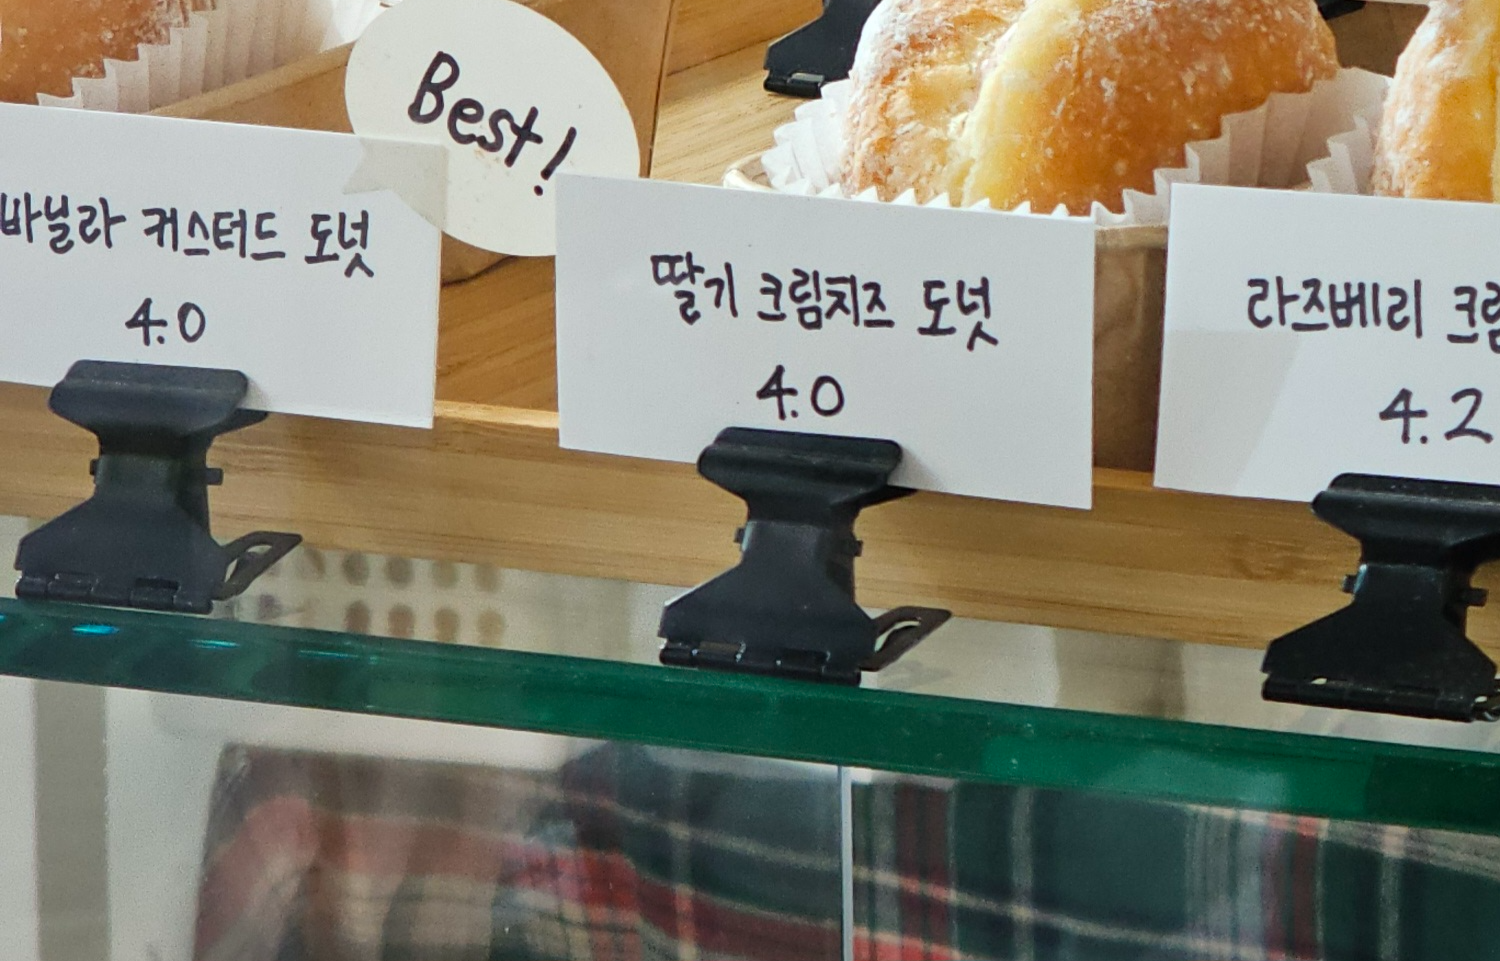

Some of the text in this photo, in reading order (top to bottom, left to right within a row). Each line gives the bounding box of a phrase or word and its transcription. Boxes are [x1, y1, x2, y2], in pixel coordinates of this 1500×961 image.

[407, 50, 578, 197] Best!
[0, 191, 375, 278] 바닐라 커스터드 도넛
[124, 297, 206, 347] 4.0
[649, 250, 999, 352] 딸기 크림치즈 도넛
[1247, 275, 1423, 339] 라즈베리
[755, 364, 845, 421] 4.0
[1378, 387, 1494, 445] 4.2
